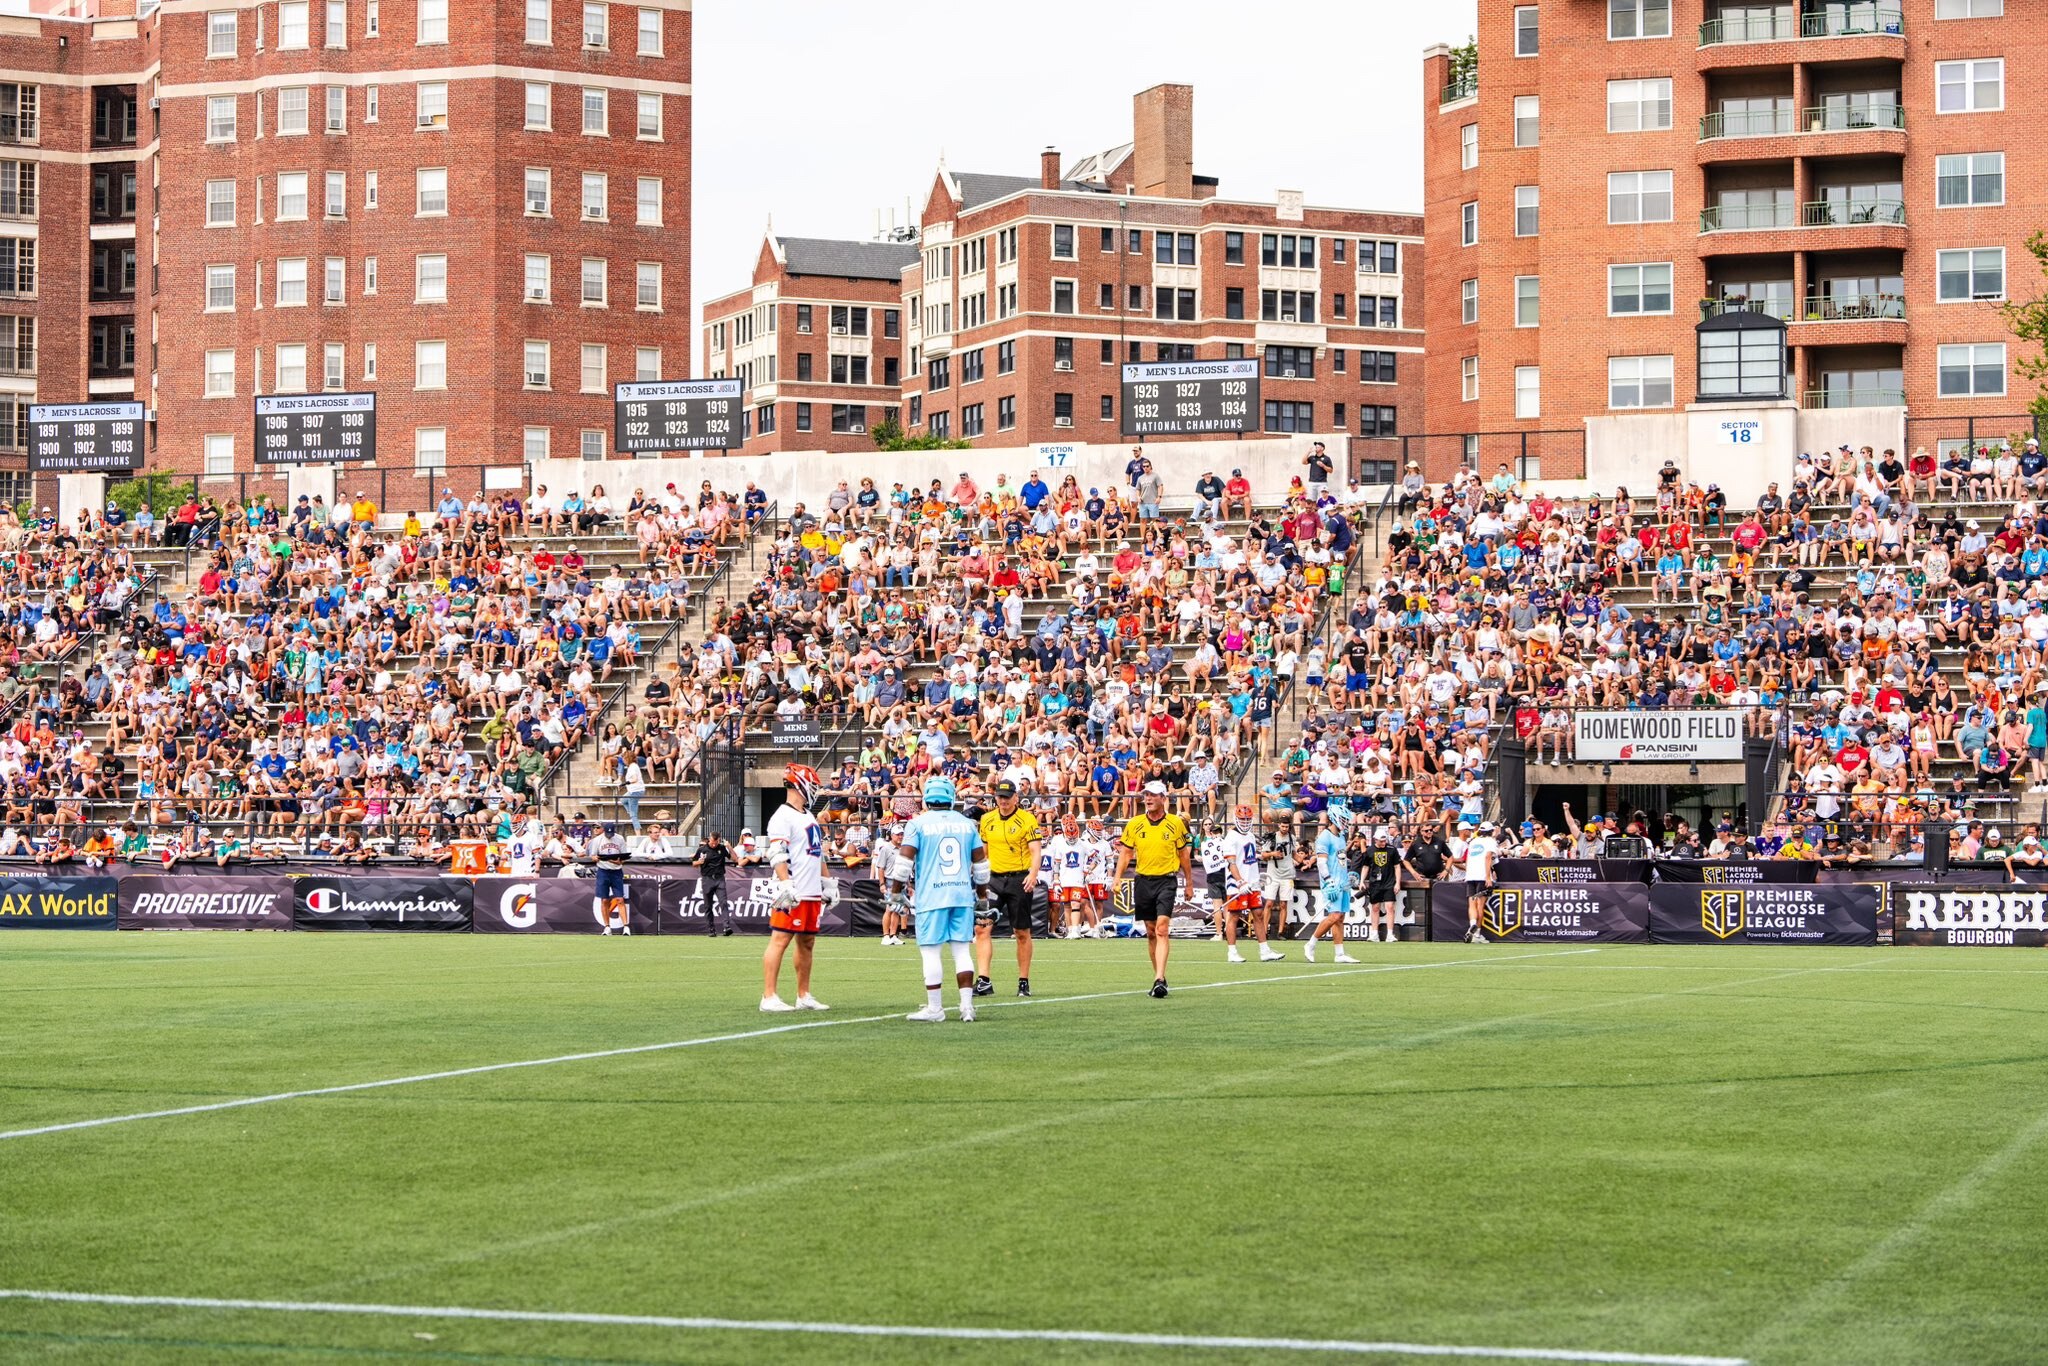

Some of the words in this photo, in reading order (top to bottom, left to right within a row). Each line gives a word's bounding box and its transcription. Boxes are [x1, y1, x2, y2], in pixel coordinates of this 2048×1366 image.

[1146, 367, 1176, 376] MEN'S
[1178, 365, 1229, 375] LACROSSE
[638, 386, 666, 395] MEN'S
[667, 385, 714, 395] LACROSSE
[1134, 384, 1159, 399] 1926
[1176, 383, 1200, 397] 1927
[1221, 381, 1247, 395] 1928
[276, 400, 303, 408] MEN'S
[305, 399, 349, 407] LACROSSE
[626, 403, 648, 417] 1915
[665, 402, 687, 415] 1918
[706, 400, 728, 414] 1919
[1134, 404, 1159, 418] 1932
[1176, 402, 1201, 417] 1933
[1221, 401, 1247, 415] 1934
[51, 408, 77, 416] MEN'S
[79, 407, 121, 416] LACROSSE
[265, 416, 288, 429] 1906
[302, 415, 324, 428] 1907
[341, 414, 364, 427] 1908
[626, 422, 649, 435] 1922
[665, 421, 688, 434] 1923
[706, 420, 730, 433] 1924
[1136, 421, 1181, 432] NATIONAL
[1186, 419, 1242, 430] CHAMPIONS
[1721, 421, 1758, 429] SECTION
[38, 424, 59, 437] 1891
[73, 423, 95, 436] 1898
[111, 422, 133, 435] 1899
[1730, 429, 1751, 443] 18
[265, 434, 288, 447] 1909
[302, 433, 321, 446] 1911
[341, 432, 362, 445] 1913
[628, 438, 671, 448] NATIONAL
[674, 437, 726, 447] CHAMPIONS
[38, 442, 60, 455] 1900
[73, 441, 95, 454] 1902
[111, 440, 133, 453] 1903
[268, 450, 307, 460] NATIONAL
[311, 449, 361, 459] CHAMPIONS
[1048, 453, 1066, 466] 17
[40, 457, 79, 468] NATIONAL
[82, 456, 130, 467] CHAMPIONS
[1254, 697, 1267, 710] 16
[1580, 717, 1682, 739] HOMEWOOD
[1688, 717, 1736, 738] FIELD
[773, 735, 819, 744] RESTROOM
[1636, 744, 1698, 752] PANSINI
[939, 837, 962, 876] 9
[1523, 889, 1588, 900] PREMIER
[1746, 890, 1813, 901] PREMIER
[132, 893, 276, 915] PROGRESSIVE
[305, 887, 461, 922] Champion
[500, 883, 538, 928] G
[1523, 902, 1599, 913] LACROSSE
[1746, 904, 1825, 915] LACROSSE
[1905, 891, 2048, 931] REBEL
[1523, 915, 1581, 926] LEAGUE
[1746, 917, 1806, 928] LEAGUE
[1947, 930, 2014, 944] BOURBON
